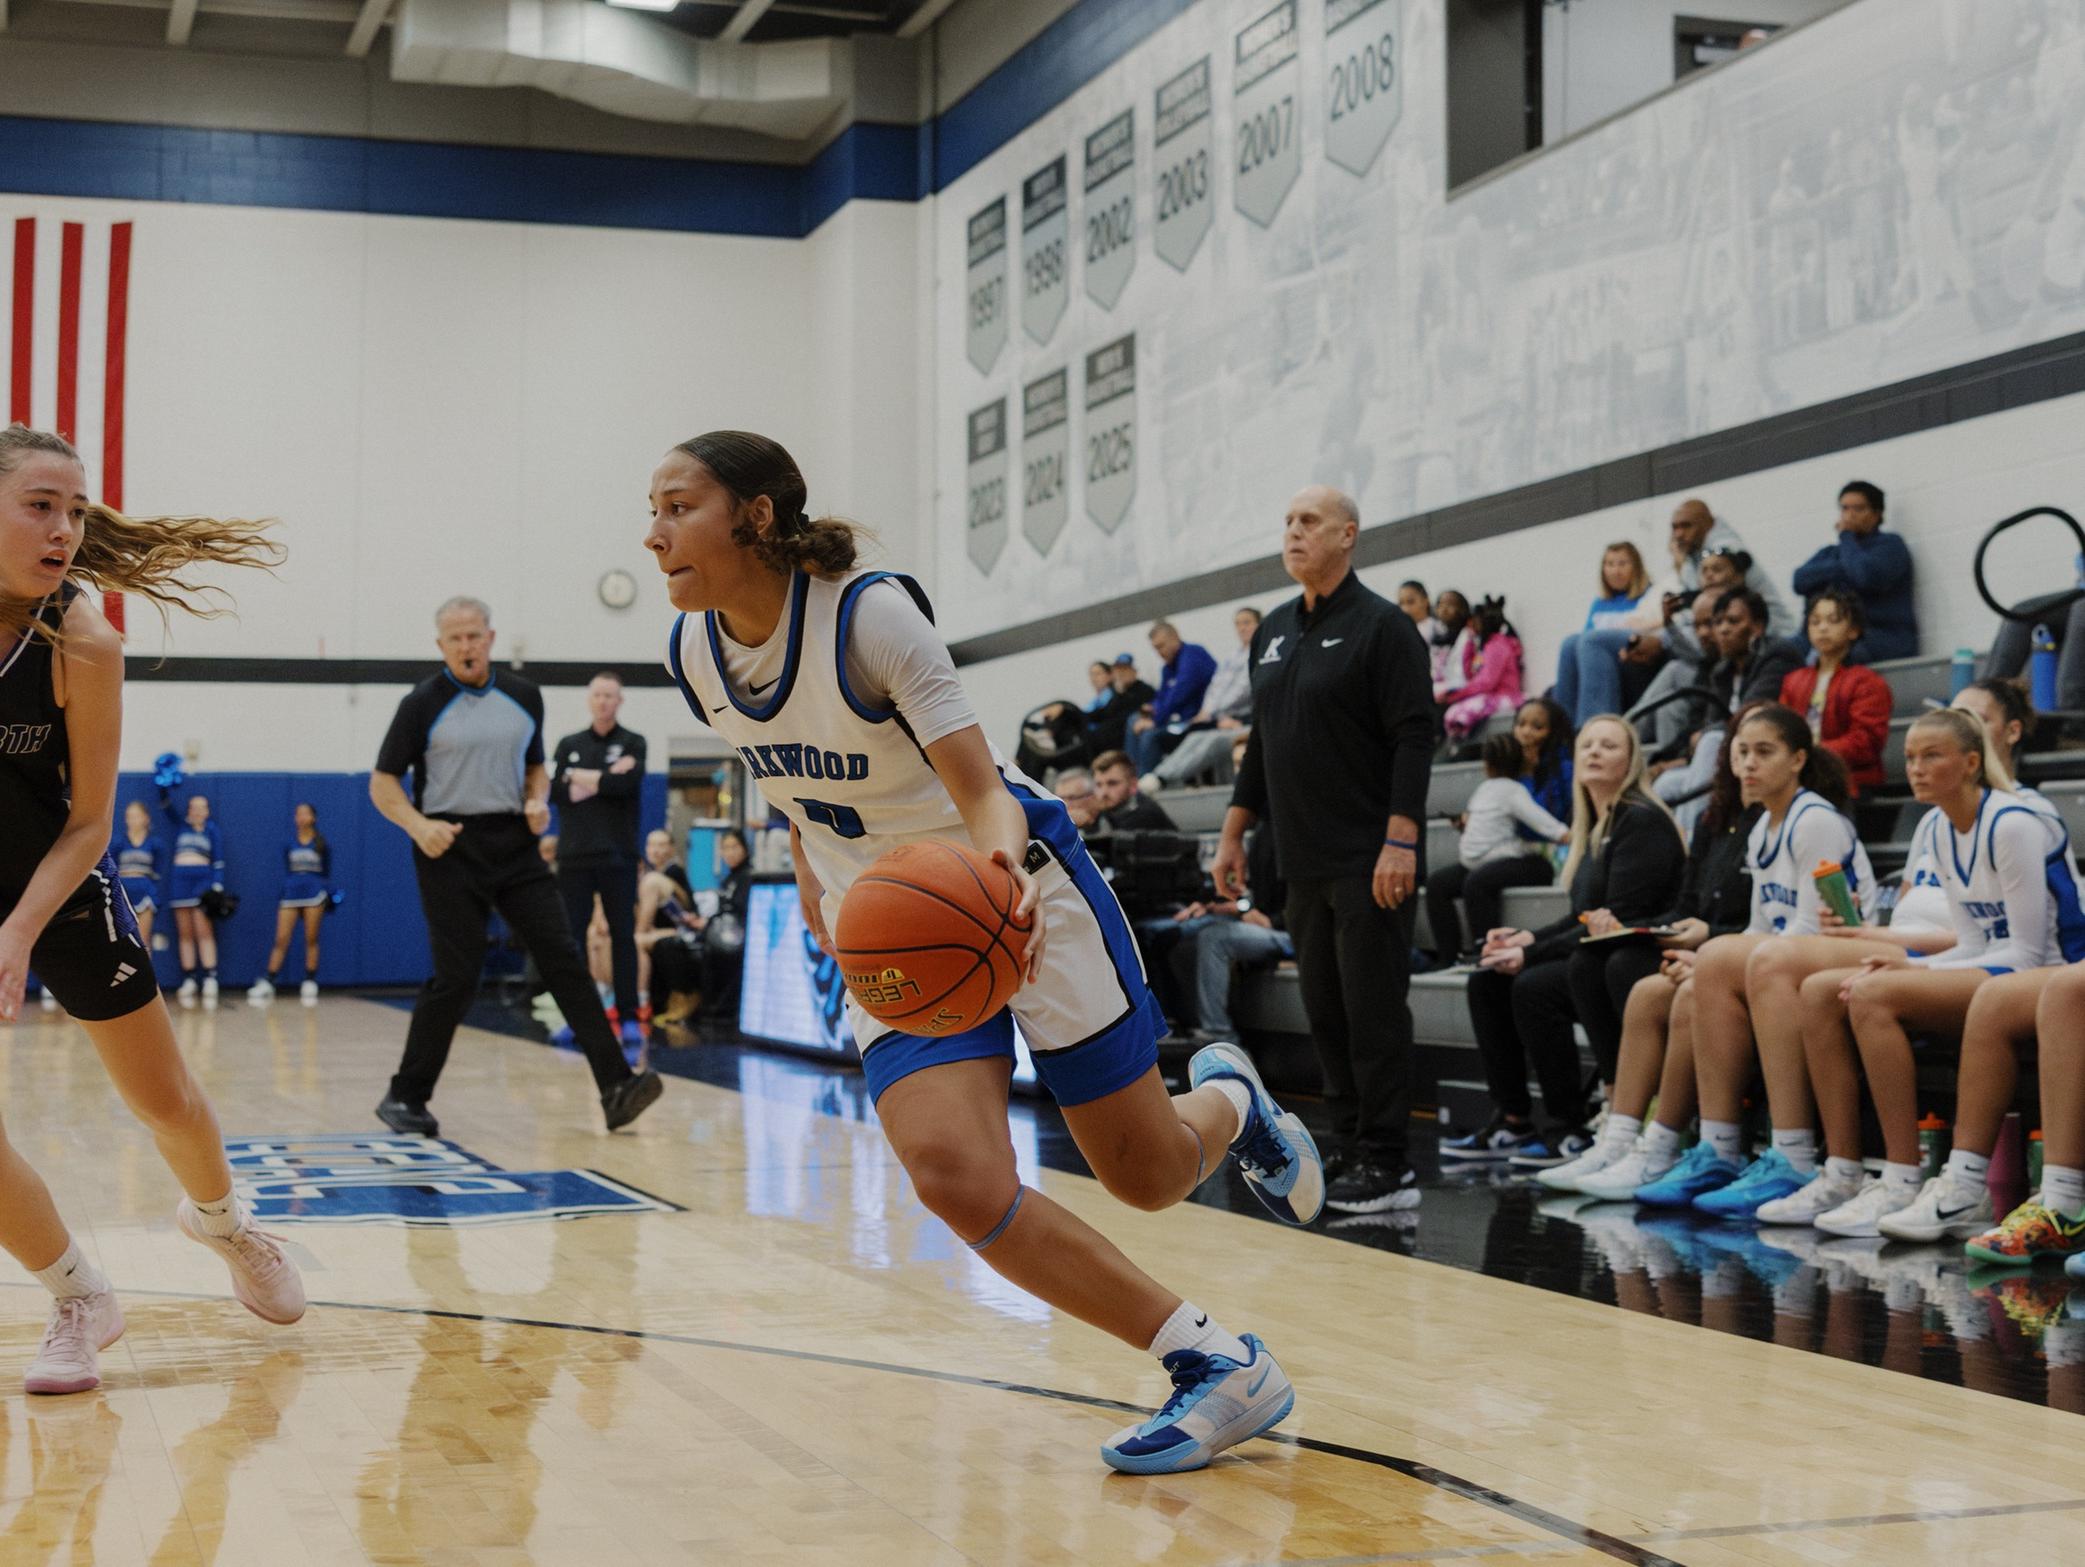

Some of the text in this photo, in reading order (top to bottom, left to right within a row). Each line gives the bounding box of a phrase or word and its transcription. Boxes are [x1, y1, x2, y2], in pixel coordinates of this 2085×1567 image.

[1330, 32, 1394, 122] 2008
[1238, 94, 1294, 175] 2007
[1158, 148, 1208, 222] 2003
[1087, 195, 1132, 264] 2002
[1089, 420, 1132, 484] 2025
[735, 743, 870, 781] RKWOOD
